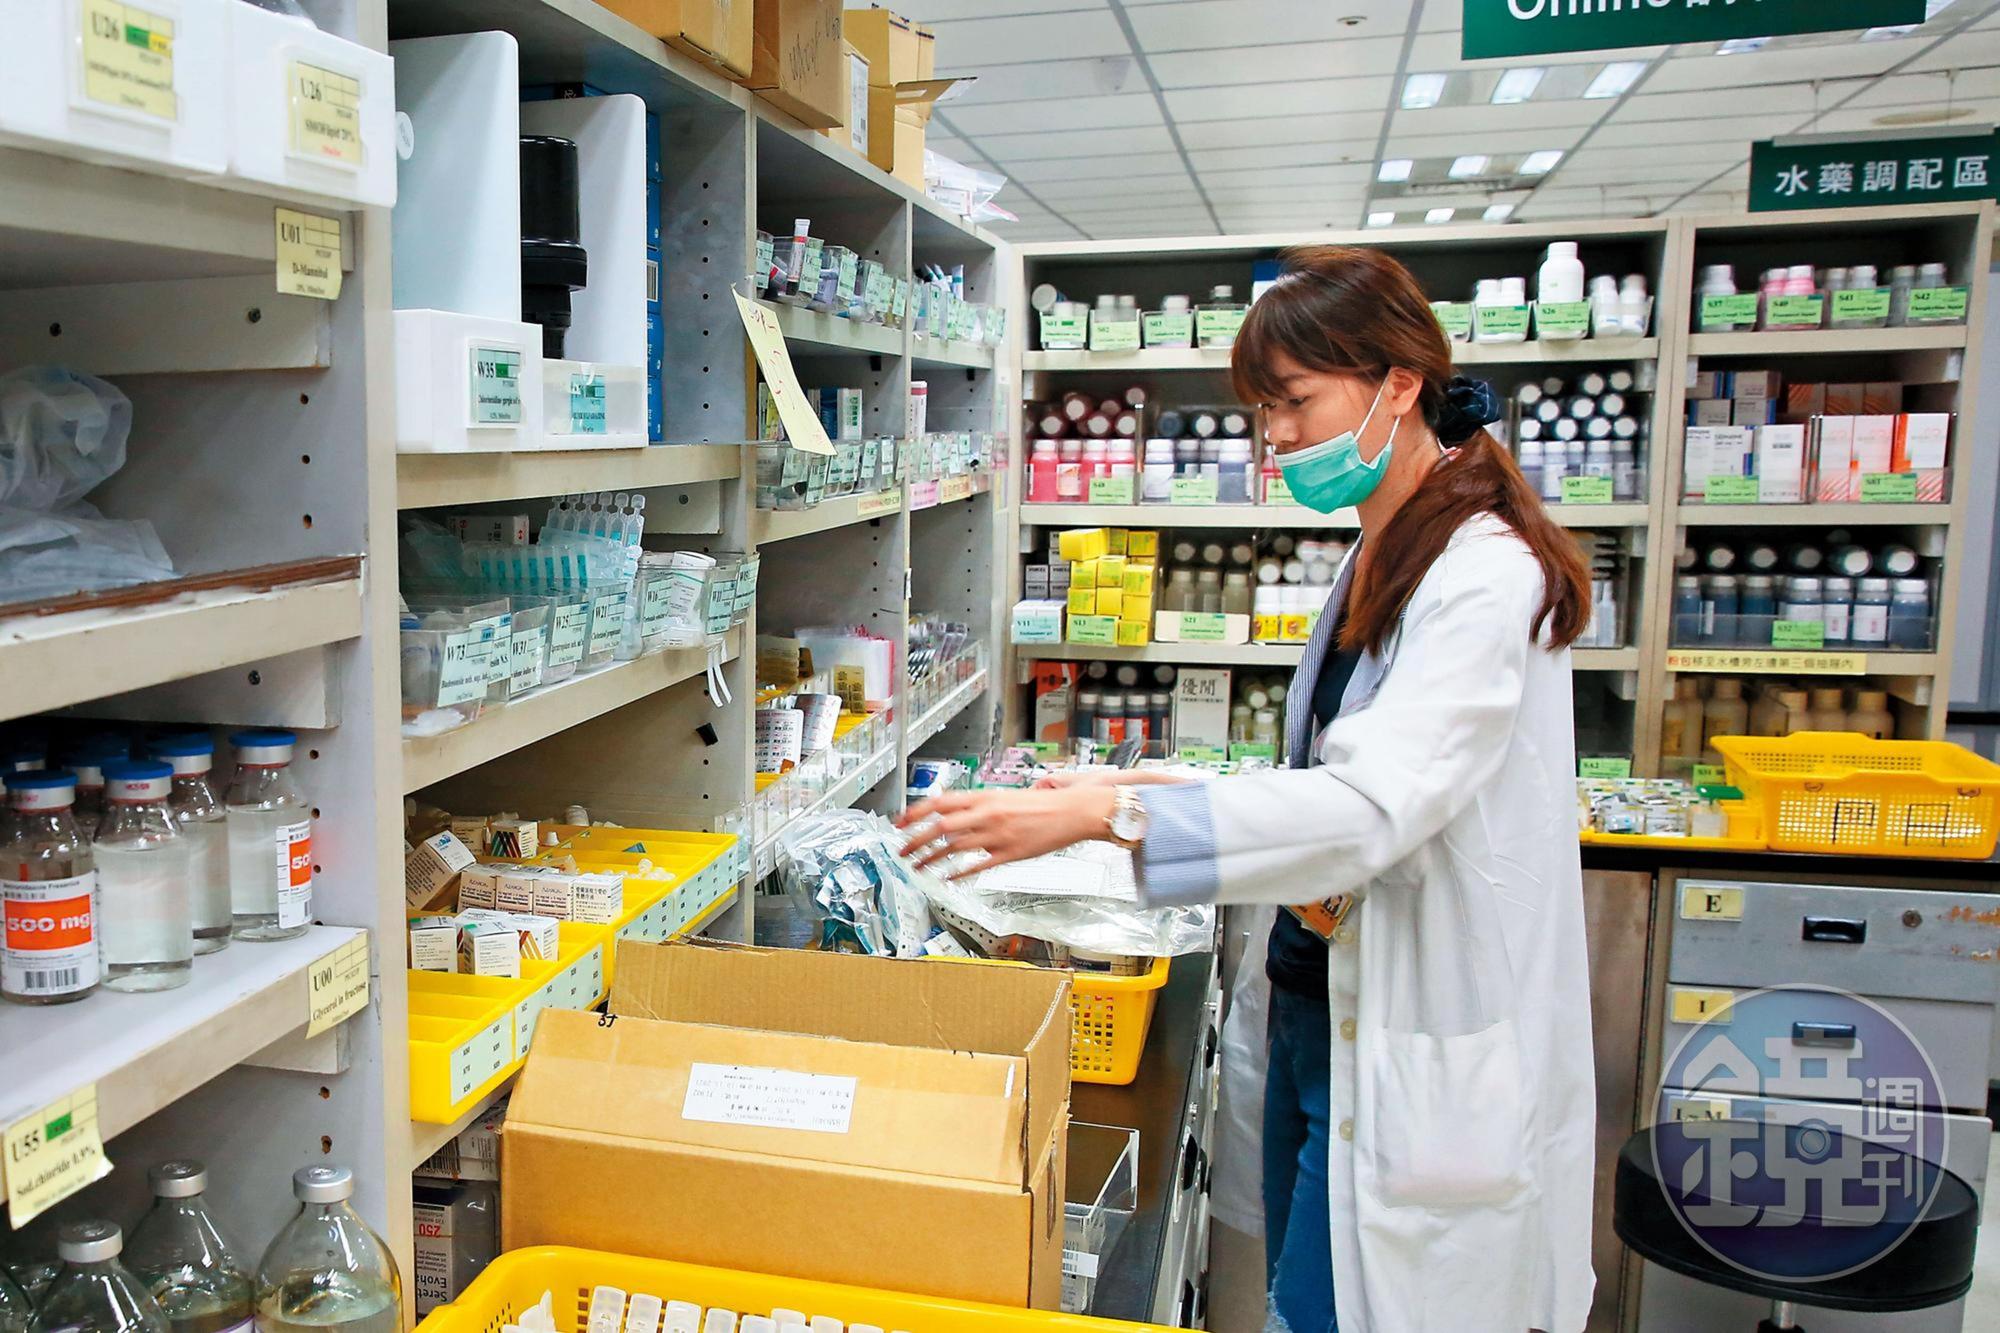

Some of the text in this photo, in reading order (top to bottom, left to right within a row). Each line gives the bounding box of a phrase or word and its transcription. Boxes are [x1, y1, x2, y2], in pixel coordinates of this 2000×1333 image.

[300, 76, 322, 102] U26
[1774, 155, 1989, 196] 水藥調配區
[281, 222, 301, 245] U01
[477, 362, 495, 379] W35
[447, 643, 466, 662] W73
[1705, 894, 1722, 913] E
[7, 912, 91, 933] 500 mg
[313, 966, 333, 992] U00
[12, 1129, 40, 1163] U55
[418, 1223, 442, 1239] 250
